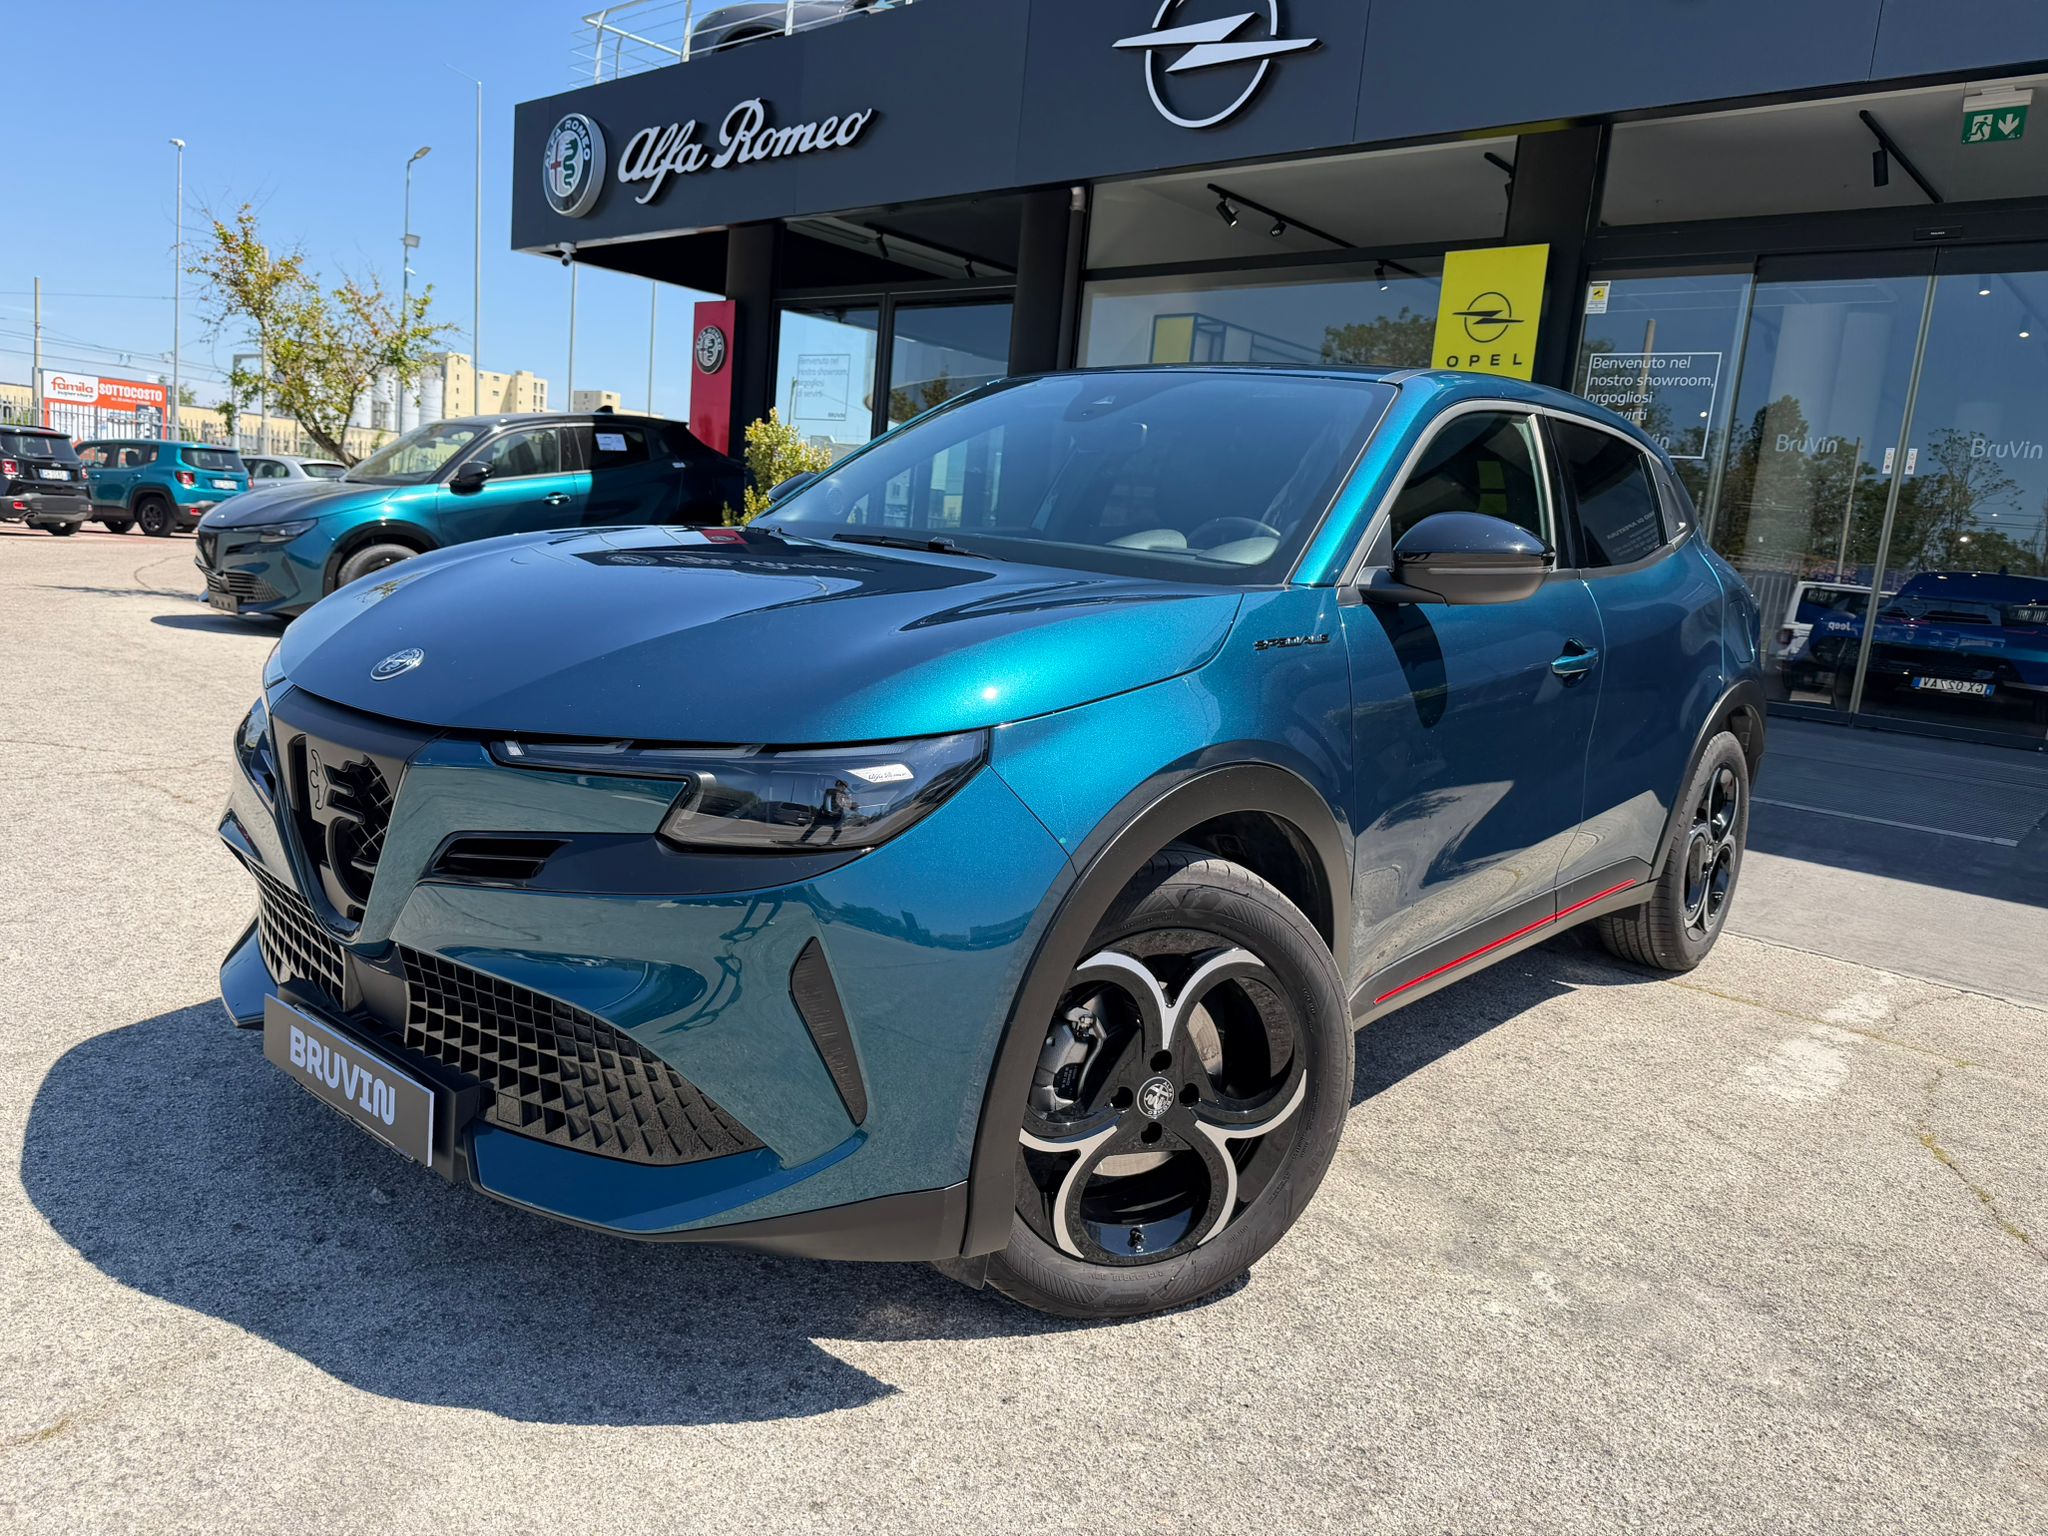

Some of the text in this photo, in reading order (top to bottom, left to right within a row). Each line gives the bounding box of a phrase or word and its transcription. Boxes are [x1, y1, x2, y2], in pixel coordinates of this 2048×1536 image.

[565, 120, 591, 161] ROMEO
[617, 97, 873, 204] Alfa Romeo
[1446, 353, 1522, 368] OPEL
[1592, 356, 1691, 369] Benvenuto nel
[51, 377, 94, 393] famila
[1589, 374, 1715, 388] nostro showroom,
[99, 383, 163, 402] SOTTOCOSTO
[1587, 391, 1653, 406] orgogliosi
[1617, 408, 1648, 421] virti
[1775, 434, 1838, 454] BruVin
[1970, 438, 2043, 459] BruVin
[289, 1024, 396, 1126] BRUVIN
